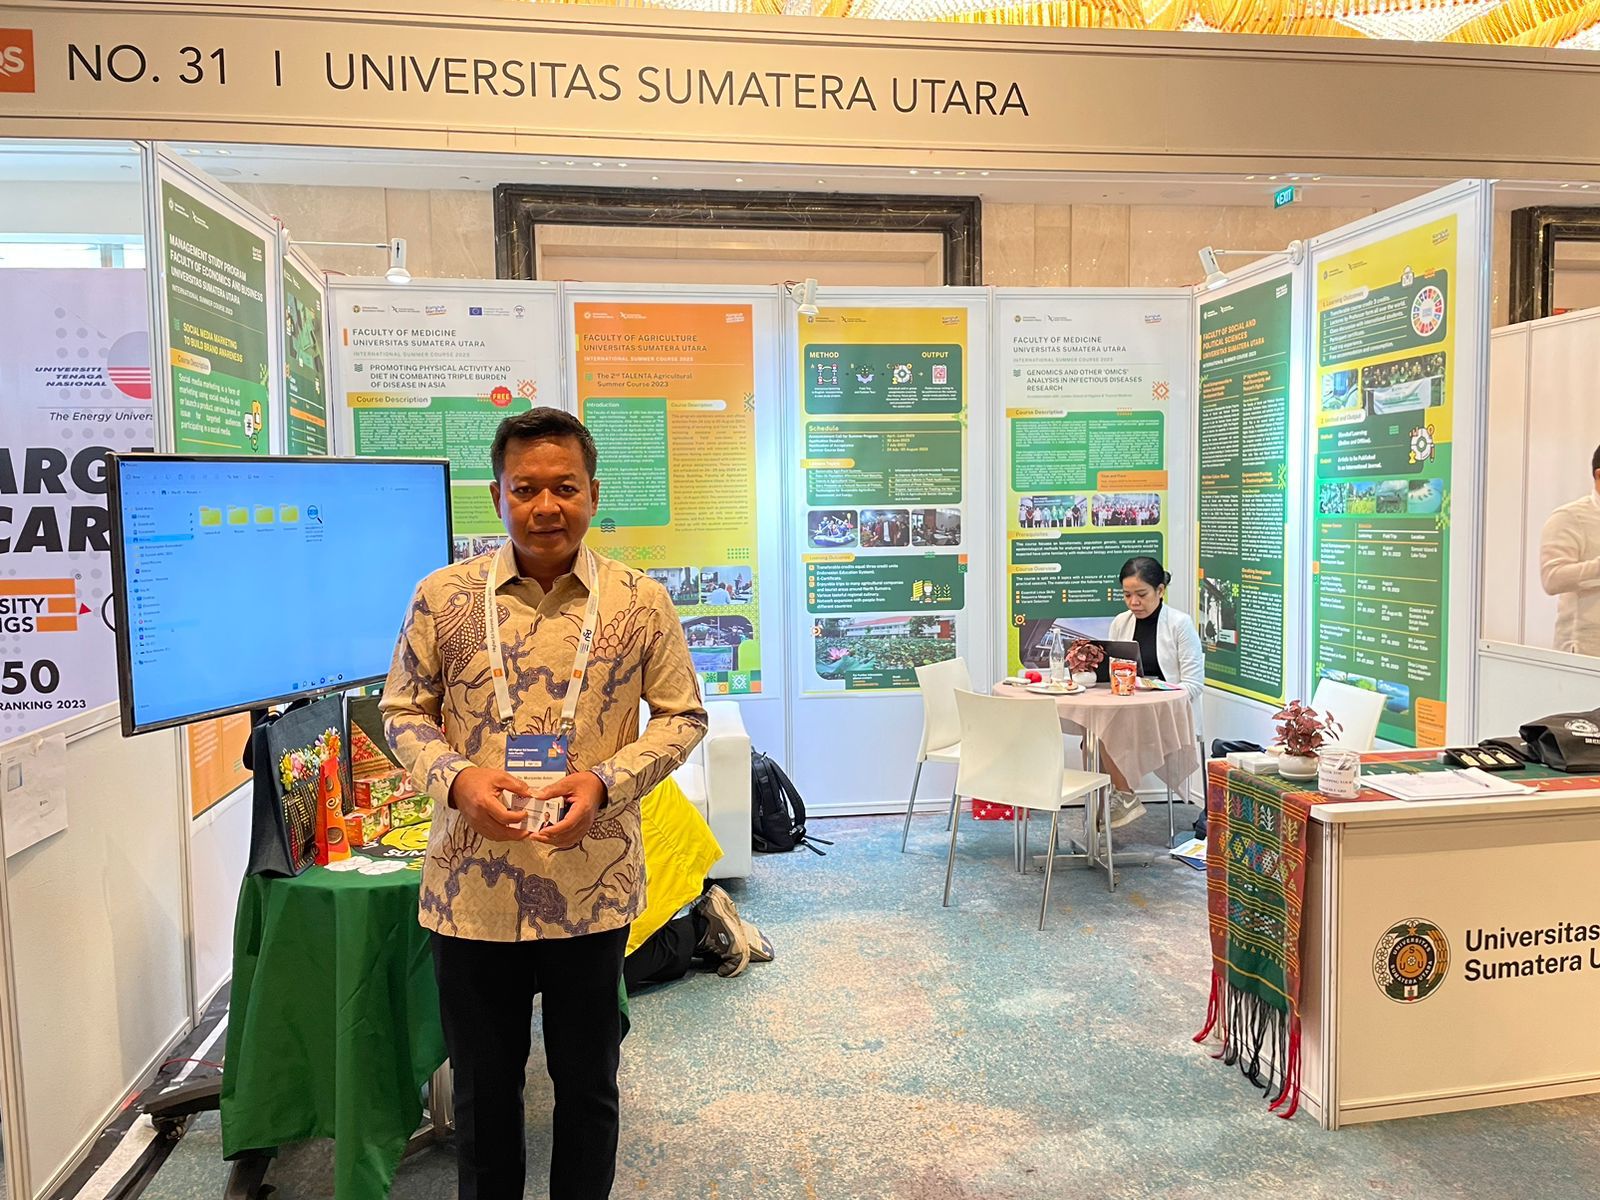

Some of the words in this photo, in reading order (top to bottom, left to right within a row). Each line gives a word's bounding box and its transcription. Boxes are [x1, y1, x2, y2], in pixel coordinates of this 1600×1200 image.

[68, 44, 159, 84] NO.
[179, 47, 226, 84] 31
[326, 52, 622, 102] UNIVERSITAS
[638, 66, 876, 111] SUMATERA
[892, 78, 1029, 116] UTARA
[1280, 189, 1292, 205] EXIT
[169, 233, 208, 263] MANAGEMENT
[208, 253, 224, 271] STUDY
[224, 261, 246, 281] PROGRAM
[170, 249, 194, 271] FACULTY
[194, 260, 201, 274] OF
[201, 264, 231, 288] ECONOMICS
[231, 278, 240, 292] AND
[241, 282, 263, 303] BUSINESS
[170, 265, 202, 289] UNIVERSITAS
[202, 278, 225, 299] SUMATERA
[226, 288, 240, 305] UTARA
[183, 322, 200, 337] SOCIAL
[200, 328, 214, 342] MEDIA
[214, 333, 237, 350] MARKETING
[412, 329, 456, 337] MEDICINE
[1202, 328, 1220, 340] FACULTY
[1221, 326, 1227, 335] OF
[1228, 322, 1244, 334] SOCIAL
[1245, 318, 1256, 329] AND
[184, 335, 190, 347] TO
[191, 337, 204, 351] BUILD
[204, 342, 218, 355] BRAND
[219, 347, 243, 363] AWARENESS
[1202, 337, 1223, 350] POLITICAL
[1224, 331, 1247, 344] SCIENCES
[1202, 347, 1226, 359] UNIVERSITAS
[1227, 341, 1249, 354] SUMATERA
[1250, 338, 1264, 348] UTARA
[370, 364, 417, 372] PROMOTING
[654, 373, 693, 381] Agricultural
[385, 396, 428, 404] Description
[50, 412, 69, 421] The
[73, 412, 112, 423] Energy
[2, 659, 60, 694] 50
[57, 699, 86, 709] 2023
[1392, 938, 1431, 955] UNIVERSITAS
[1466, 922, 1600, 952] Universitas
[1409, 946, 1415, 954] S
[1390, 964, 1417, 985] SUMATERA
[1418, 960, 1433, 981] UTARA
[1464, 954, 1582, 982] Sumatera
